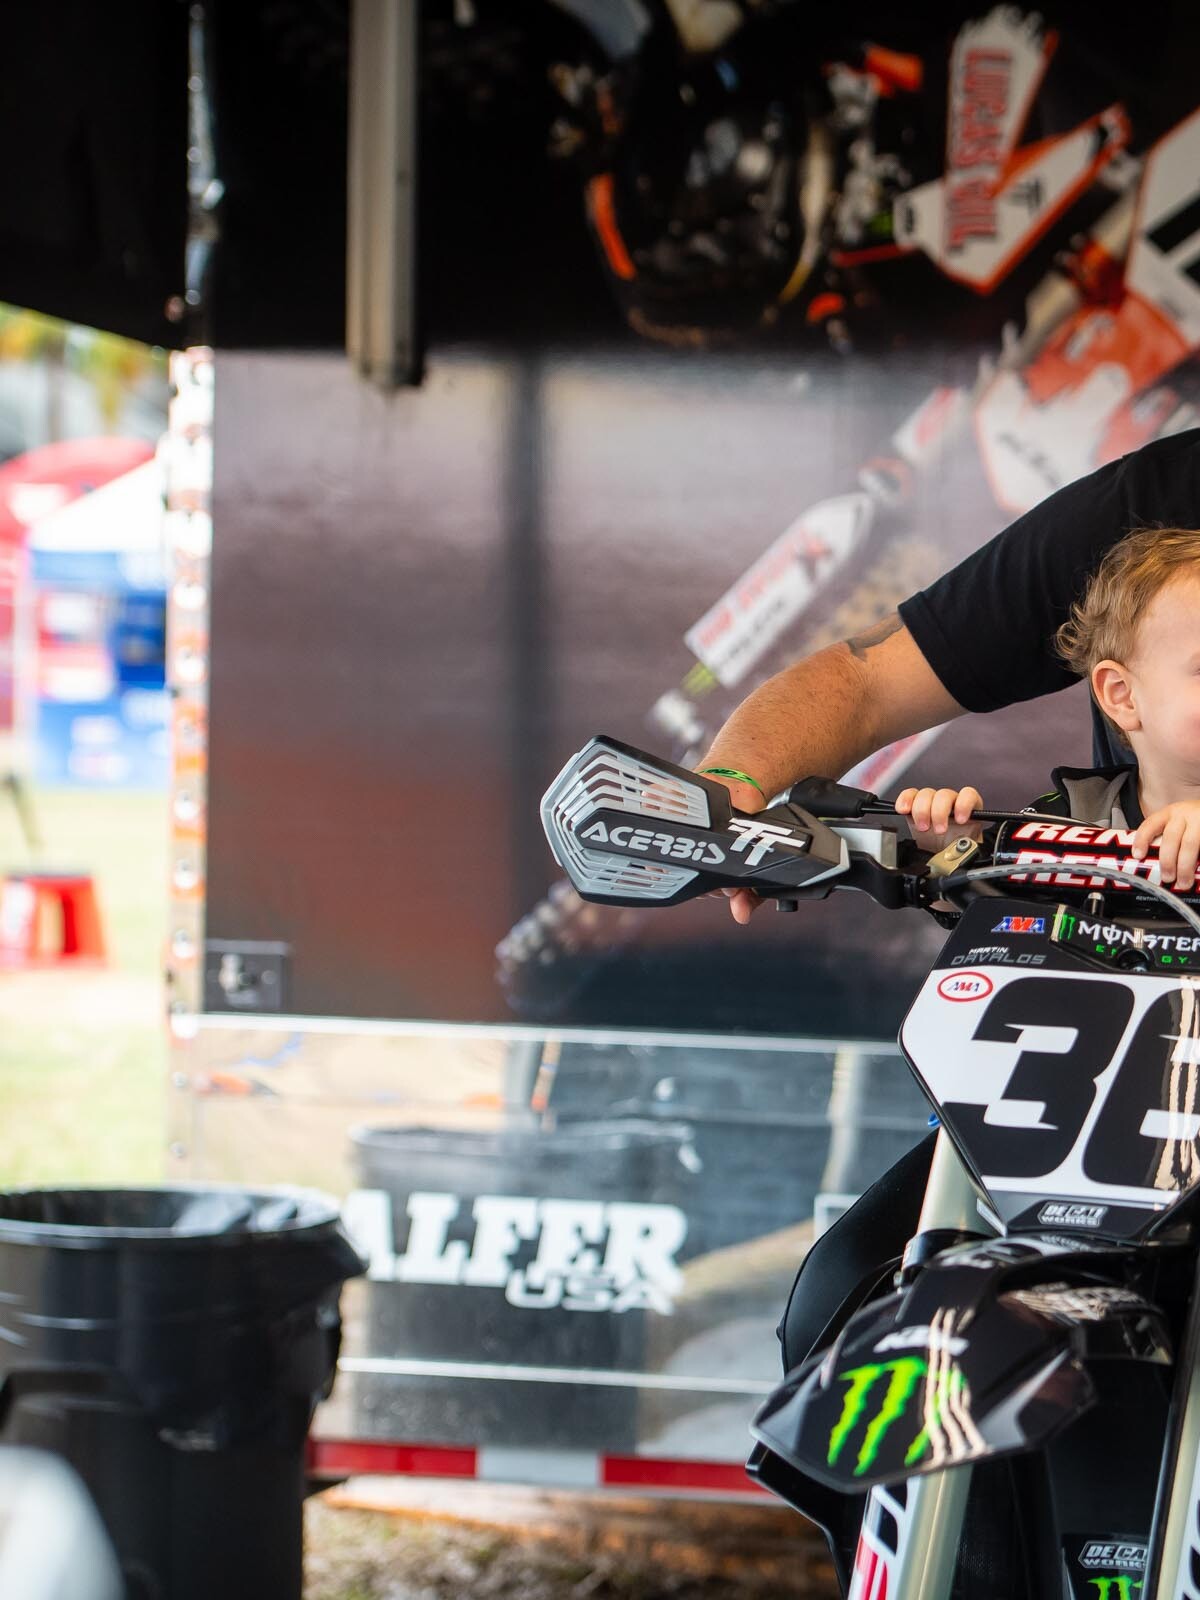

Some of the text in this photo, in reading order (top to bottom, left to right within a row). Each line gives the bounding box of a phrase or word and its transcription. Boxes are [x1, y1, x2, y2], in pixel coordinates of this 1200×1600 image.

[991, 916, 1045, 934] AMA
[950, 952, 1046, 966] DAVALOS
[1095, 944, 1191, 964] EGY
[338, 1188, 688, 1292] ALFER
[505, 1268, 676, 1315] USA
